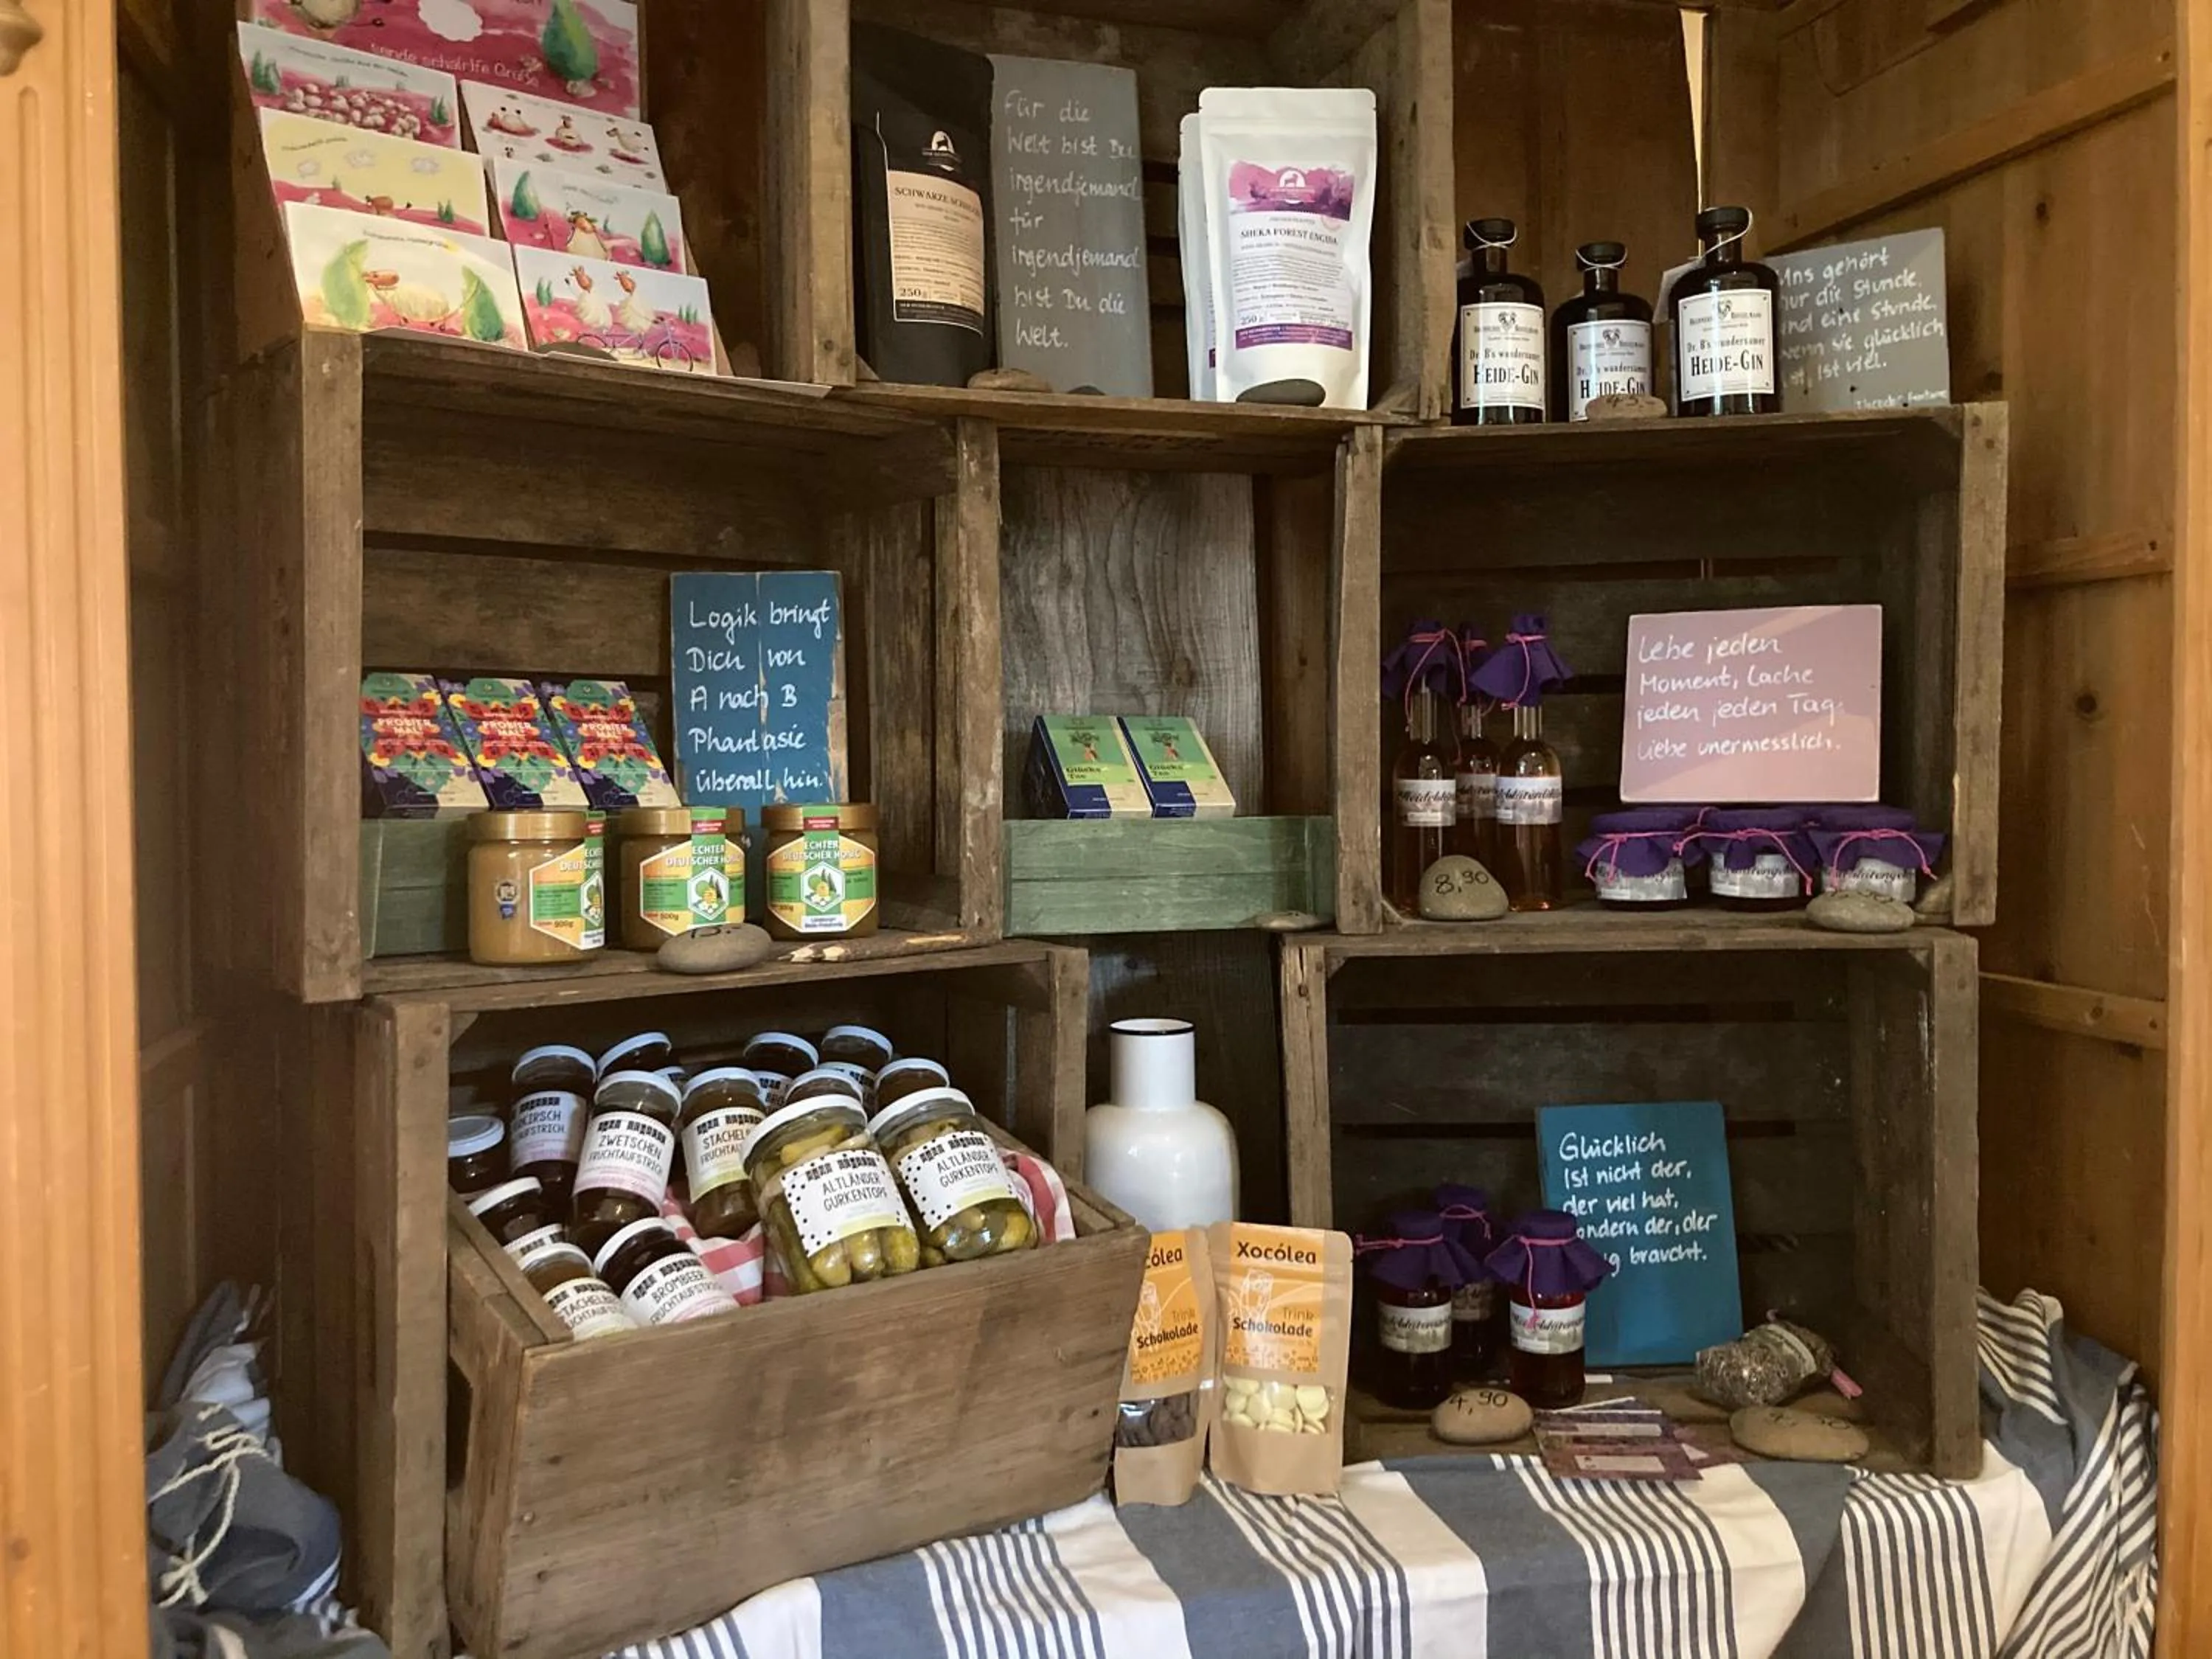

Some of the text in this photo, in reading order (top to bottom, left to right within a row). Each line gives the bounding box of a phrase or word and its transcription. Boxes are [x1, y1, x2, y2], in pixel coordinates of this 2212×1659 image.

[1004, 89, 1091, 123] Für die
[1007, 127, 1050, 154] Welt
[1062, 133, 1097, 157] bist
[1273, 227, 1308, 240] FOREST
[1822, 246, 1890, 286] gehört
[900, 288, 921, 297] 250
[1015, 285, 1127, 315] bist Du die
[1816, 285, 1842, 307] die
[1821, 307, 1860, 328] eine
[1832, 332, 1854, 352] sie
[1864, 317, 1945, 355] glücklich
[1474, 364, 1540, 385] HEIDE-GIN
[1691, 349, 1764, 377] HEIDE-GIN
[1581, 376, 1645, 399] HIDE-GIN
[689, 598, 831, 645] Logik bringt
[686, 647, 806, 672] Dich von
[1639, 633, 1783, 664] Lebe jeden
[690, 684, 798, 712] A nach B
[1638, 701, 1699, 730] jeden
[1712, 697, 1777, 728] jeden
[688, 724, 807, 754] Phantasie
[692, 844, 724, 855] ECHTER
[804, 840, 839, 850] ECHTER
[560, 858, 602, 872] DEUTSCHE
[667, 855, 719, 869] DEUTSCHER
[1435, 870, 1489, 895] 8,90
[599, 1135, 662, 1161] ZWETSCHEN
[1559, 1131, 1666, 1162] Glücklich
[937, 1150, 990, 1174] ALTLÄNDER
[940, 1162, 998, 1188] GURKENTOPF
[1596, 1161, 1641, 1186] nicht
[822, 1171, 881, 1195] ALTLÄNDER
[824, 1186, 888, 1212] GURKENTOPF
[1562, 1194, 1599, 1218] der
[1606, 1192, 1635, 1215] viel
[1576, 1218, 1639, 1240] ondern
[1683, 1209, 1719, 1234] der
[1146, 1247, 1183, 1269] cólea
[1237, 1239, 1317, 1265] Xocólea
[1630, 1242, 1708, 1265] braucht.
[651, 1270, 704, 1304] BROMBEER
[1284, 1307, 1315, 1321] Trink
[1136, 1321, 1199, 1349] Schokolade
[1232, 1317, 1313, 1338] Schokolade
[1449, 1390, 1509, 1416] 4,90
